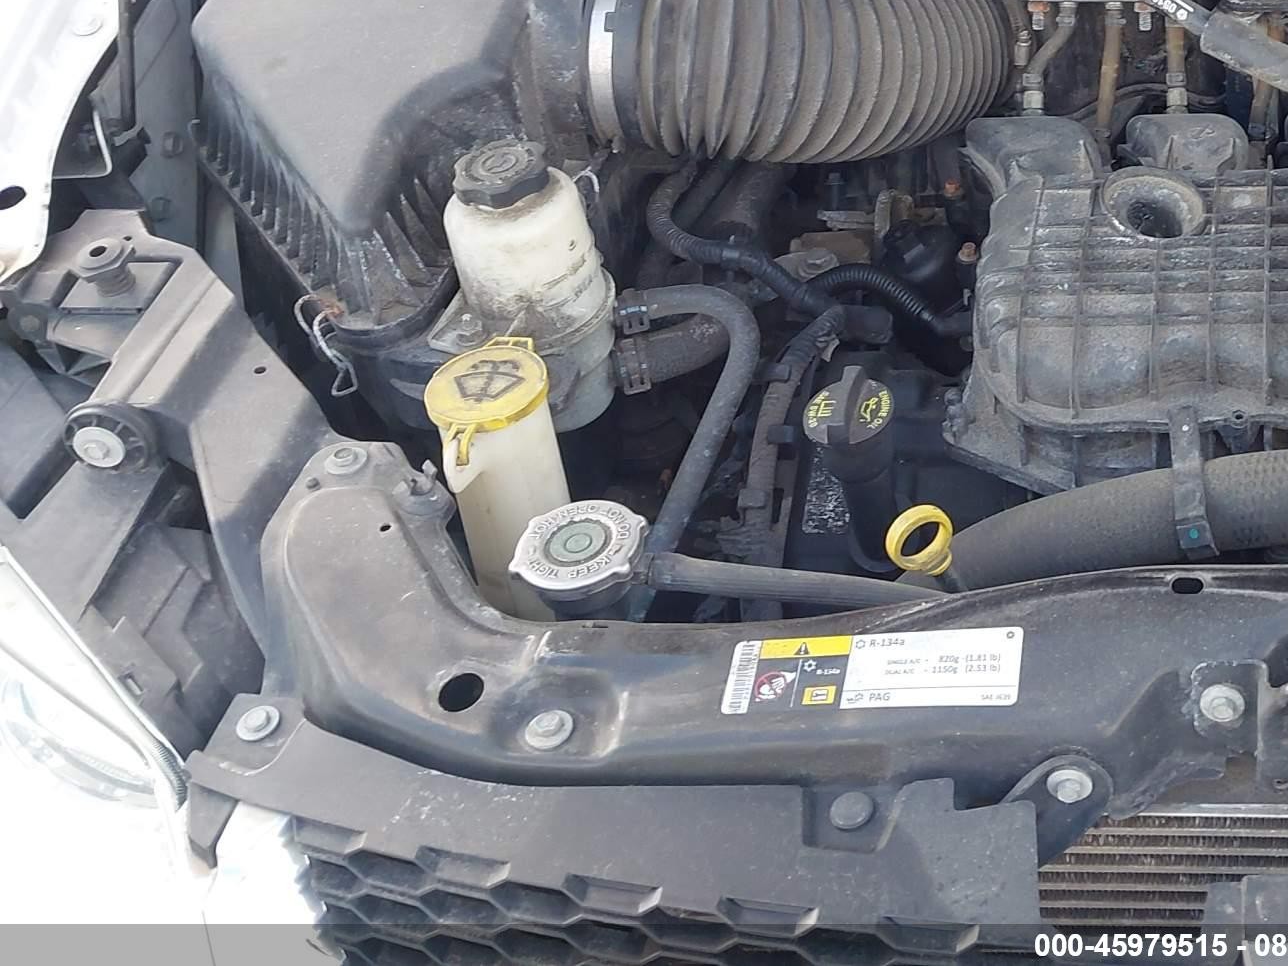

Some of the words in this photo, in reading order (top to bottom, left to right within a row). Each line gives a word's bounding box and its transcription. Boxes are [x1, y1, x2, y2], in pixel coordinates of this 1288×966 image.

[878, 390, 892, 417] ENGINE
[866, 416, 883, 430] OIL
[567, 556, 612, 579] KEEP
[869, 638, 905, 647] R-134a
[932, 665, 958, 674] 1150g
[965, 664, 987, 673] (2.53
[869, 692, 891, 702] PAG
